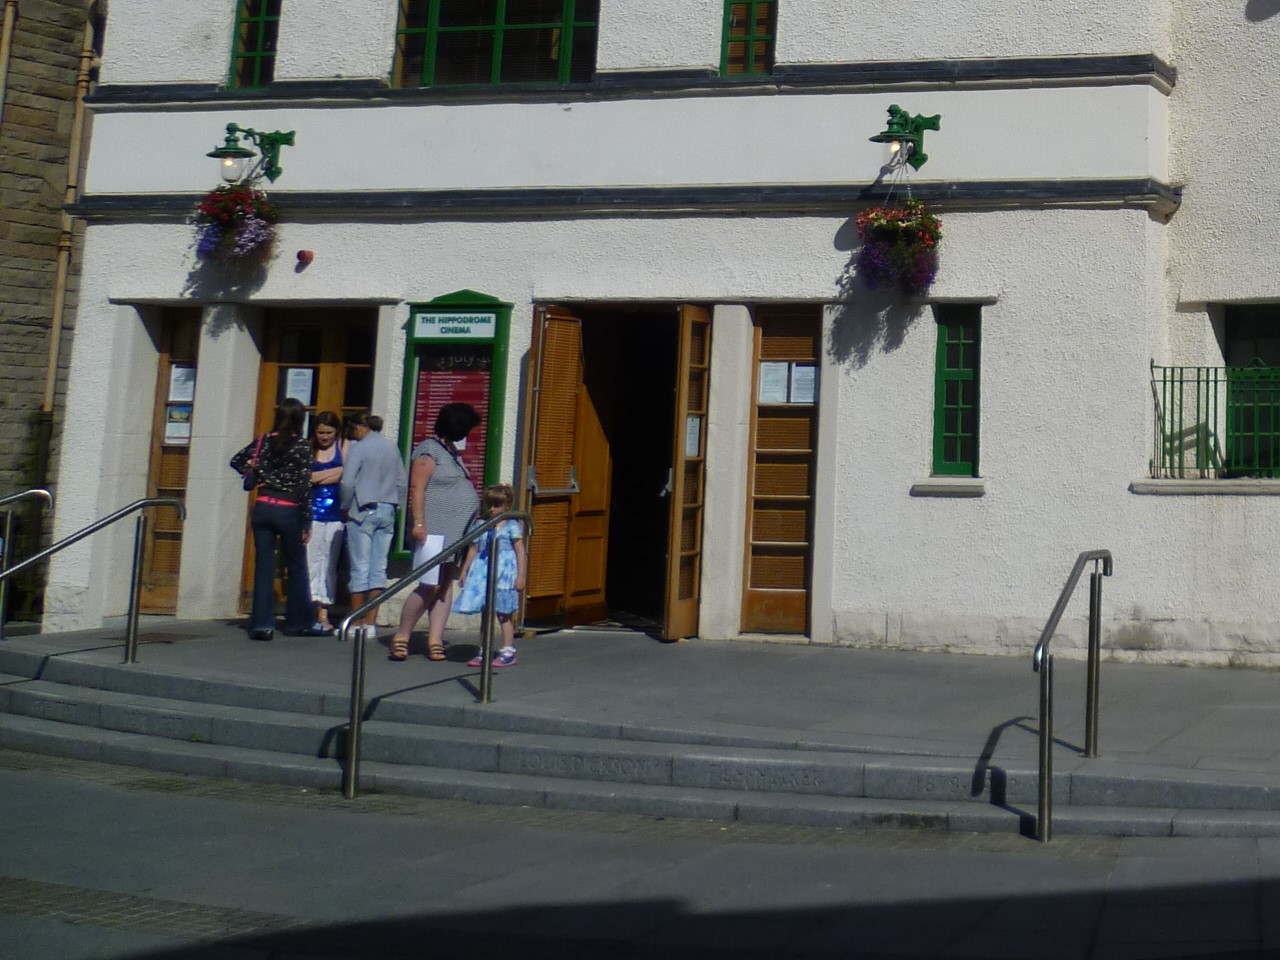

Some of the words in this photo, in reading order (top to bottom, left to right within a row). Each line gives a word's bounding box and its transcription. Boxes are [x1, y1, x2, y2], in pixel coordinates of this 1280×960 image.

[421, 316, 436, 324] THE
[438, 316, 492, 324] HIPPODROME
[440, 326, 471, 334] CINEMA
